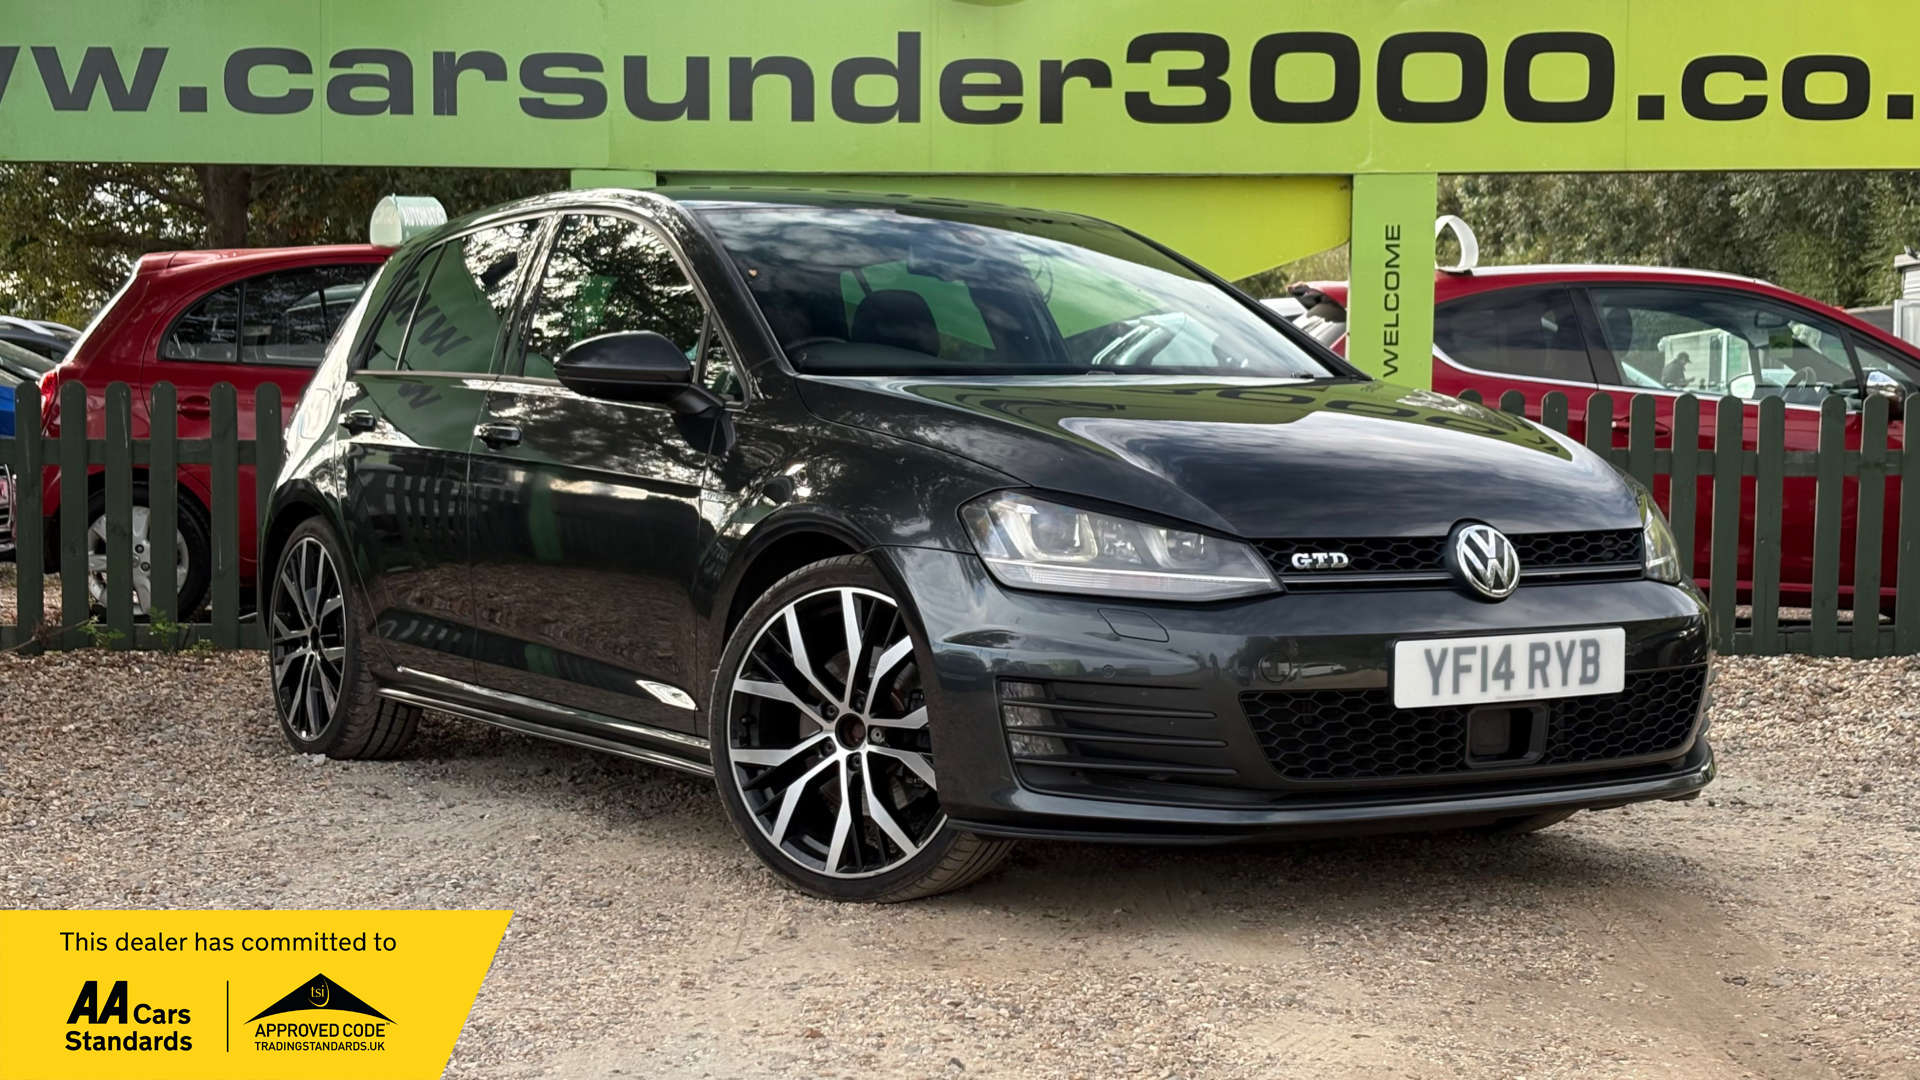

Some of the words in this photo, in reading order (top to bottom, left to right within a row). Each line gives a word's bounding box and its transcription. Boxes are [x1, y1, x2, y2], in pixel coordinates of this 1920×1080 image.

[0, 31, 1914, 125] w.carsunder3000.co.
[1383, 224, 1400, 378] WELCOME
[1291, 552, 1349, 569] GTD
[1424, 643, 1515, 697] YF14
[1528, 638, 1600, 690] RYB
